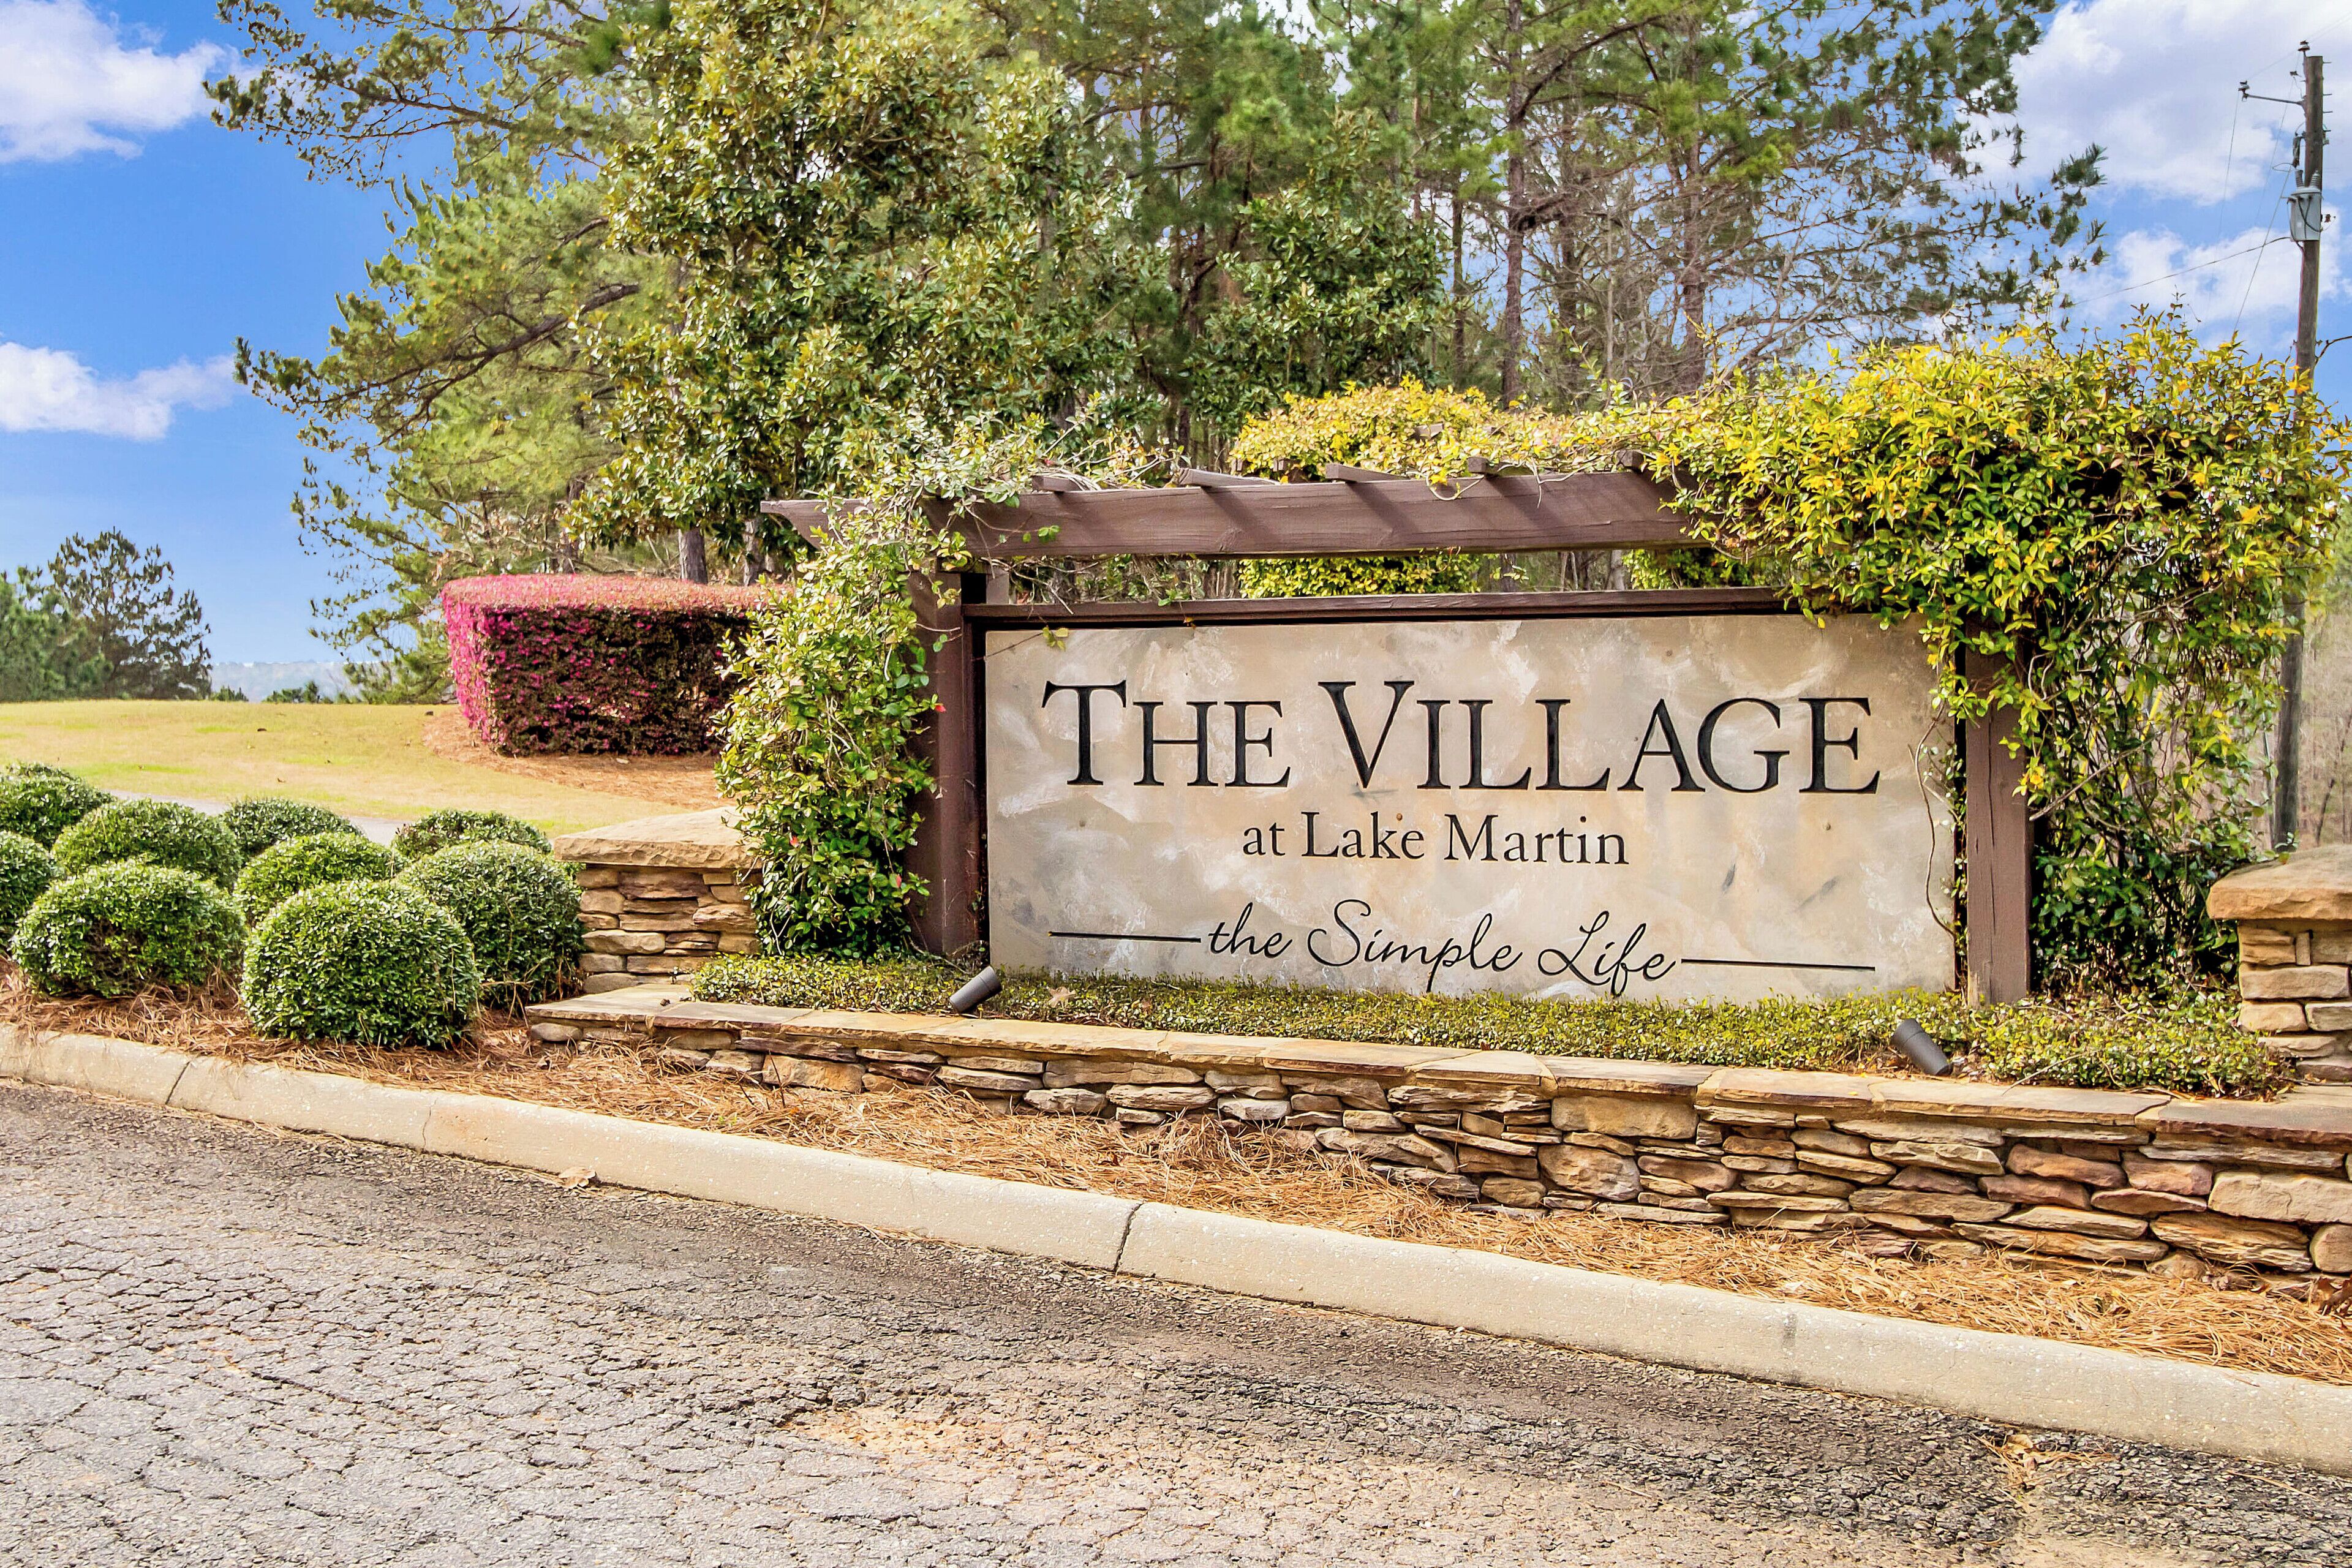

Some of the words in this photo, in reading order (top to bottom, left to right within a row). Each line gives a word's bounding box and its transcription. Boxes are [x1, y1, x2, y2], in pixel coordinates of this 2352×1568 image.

[1041, 679, 1291, 788] THE
[1317, 680, 1880, 794] VILLAGE
[1242, 821, 1286, 856] at
[1301, 810, 1425, 860] Lake
[1443, 813, 1630, 865] Martin
[1208, 901, 1294, 959] the
[1307, 899, 1524, 994] Simple
[1537, 910, 1677, 1000] Life
